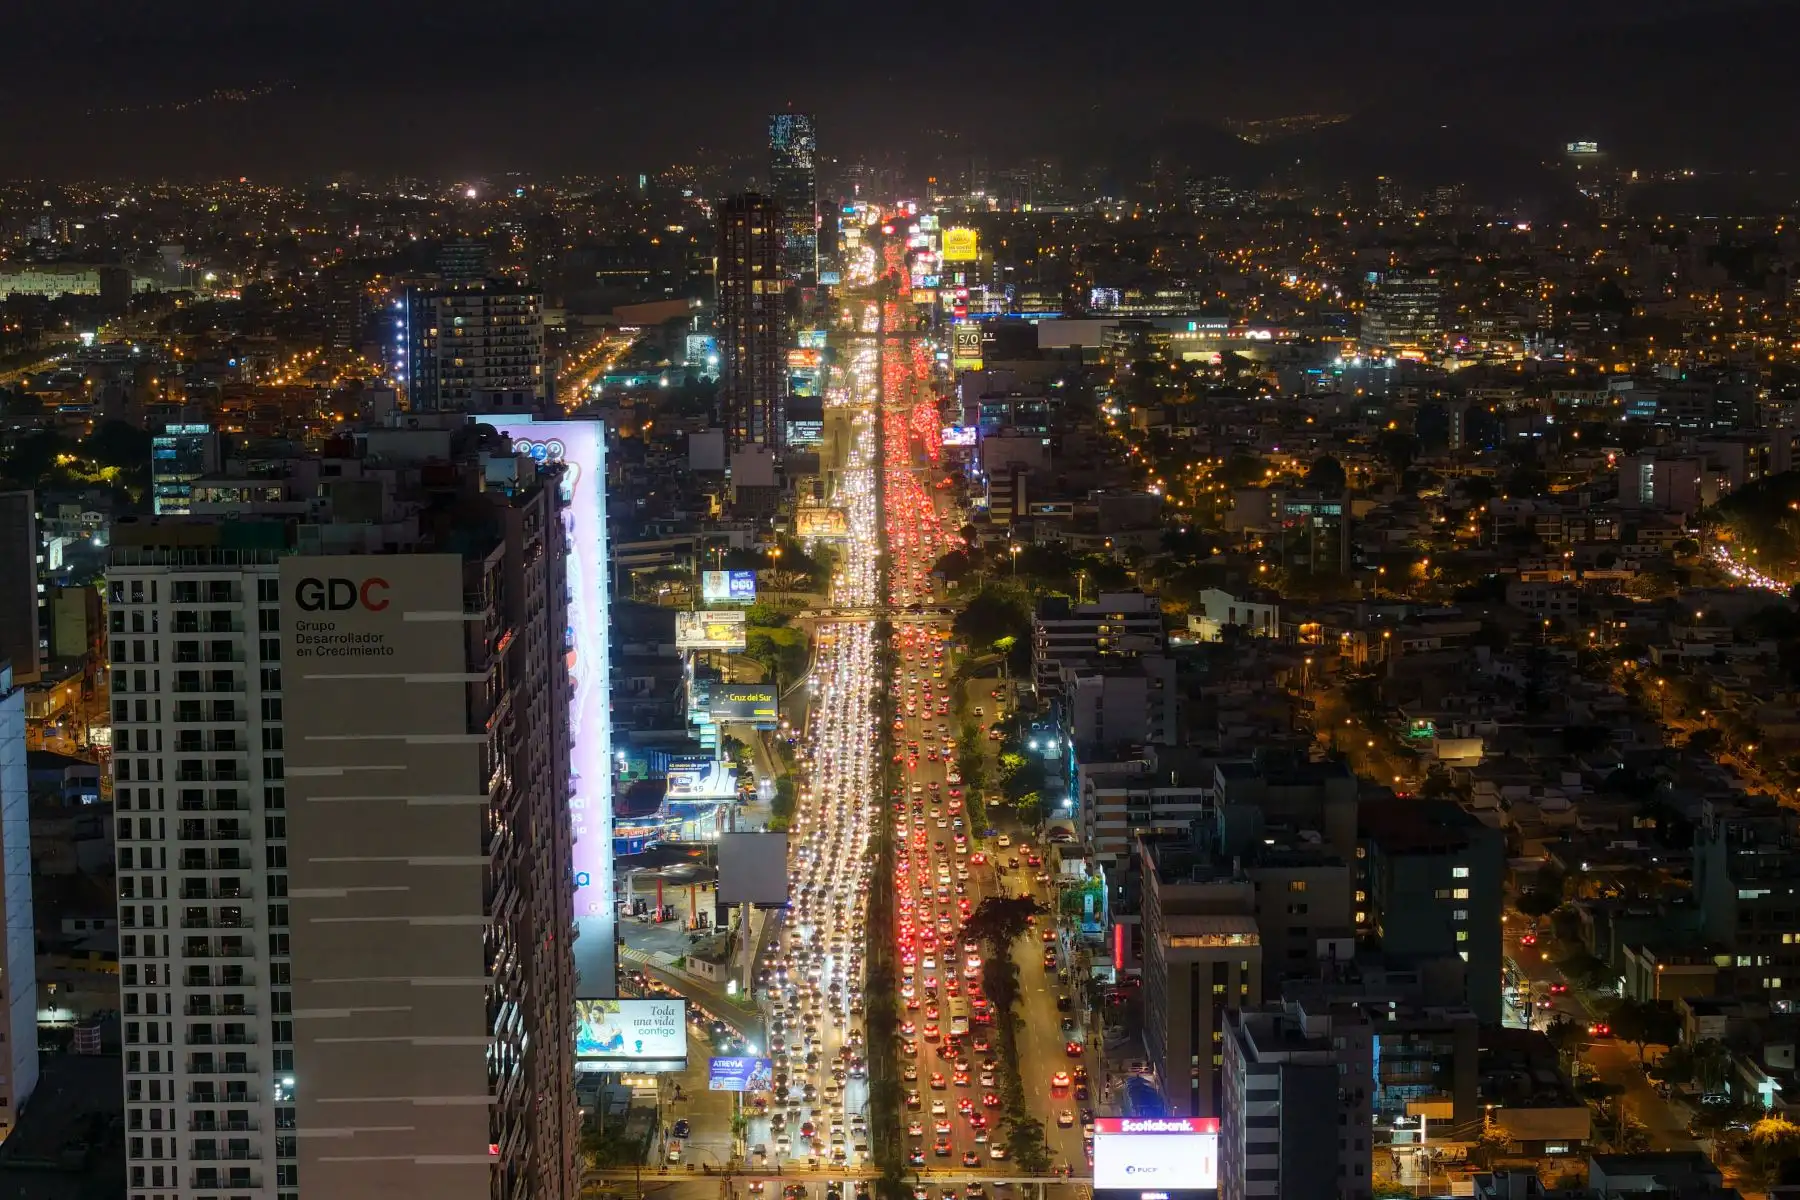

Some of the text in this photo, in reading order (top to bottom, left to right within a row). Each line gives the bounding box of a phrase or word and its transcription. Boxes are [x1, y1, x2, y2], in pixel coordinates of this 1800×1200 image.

[295, 577, 390, 612] GDC
[296, 620, 336, 632] Grupo
[296, 632, 385, 644] Desarrollador
[296, 645, 394, 657] en Crecimiento
[730, 693, 772, 701] Cruz del Sur
[651, 1005, 675, 1016] Toda
[654, 1016, 675, 1026] vida
[638, 1027, 676, 1037] contigo
[713, 1060, 744, 1068] ATREVIA
